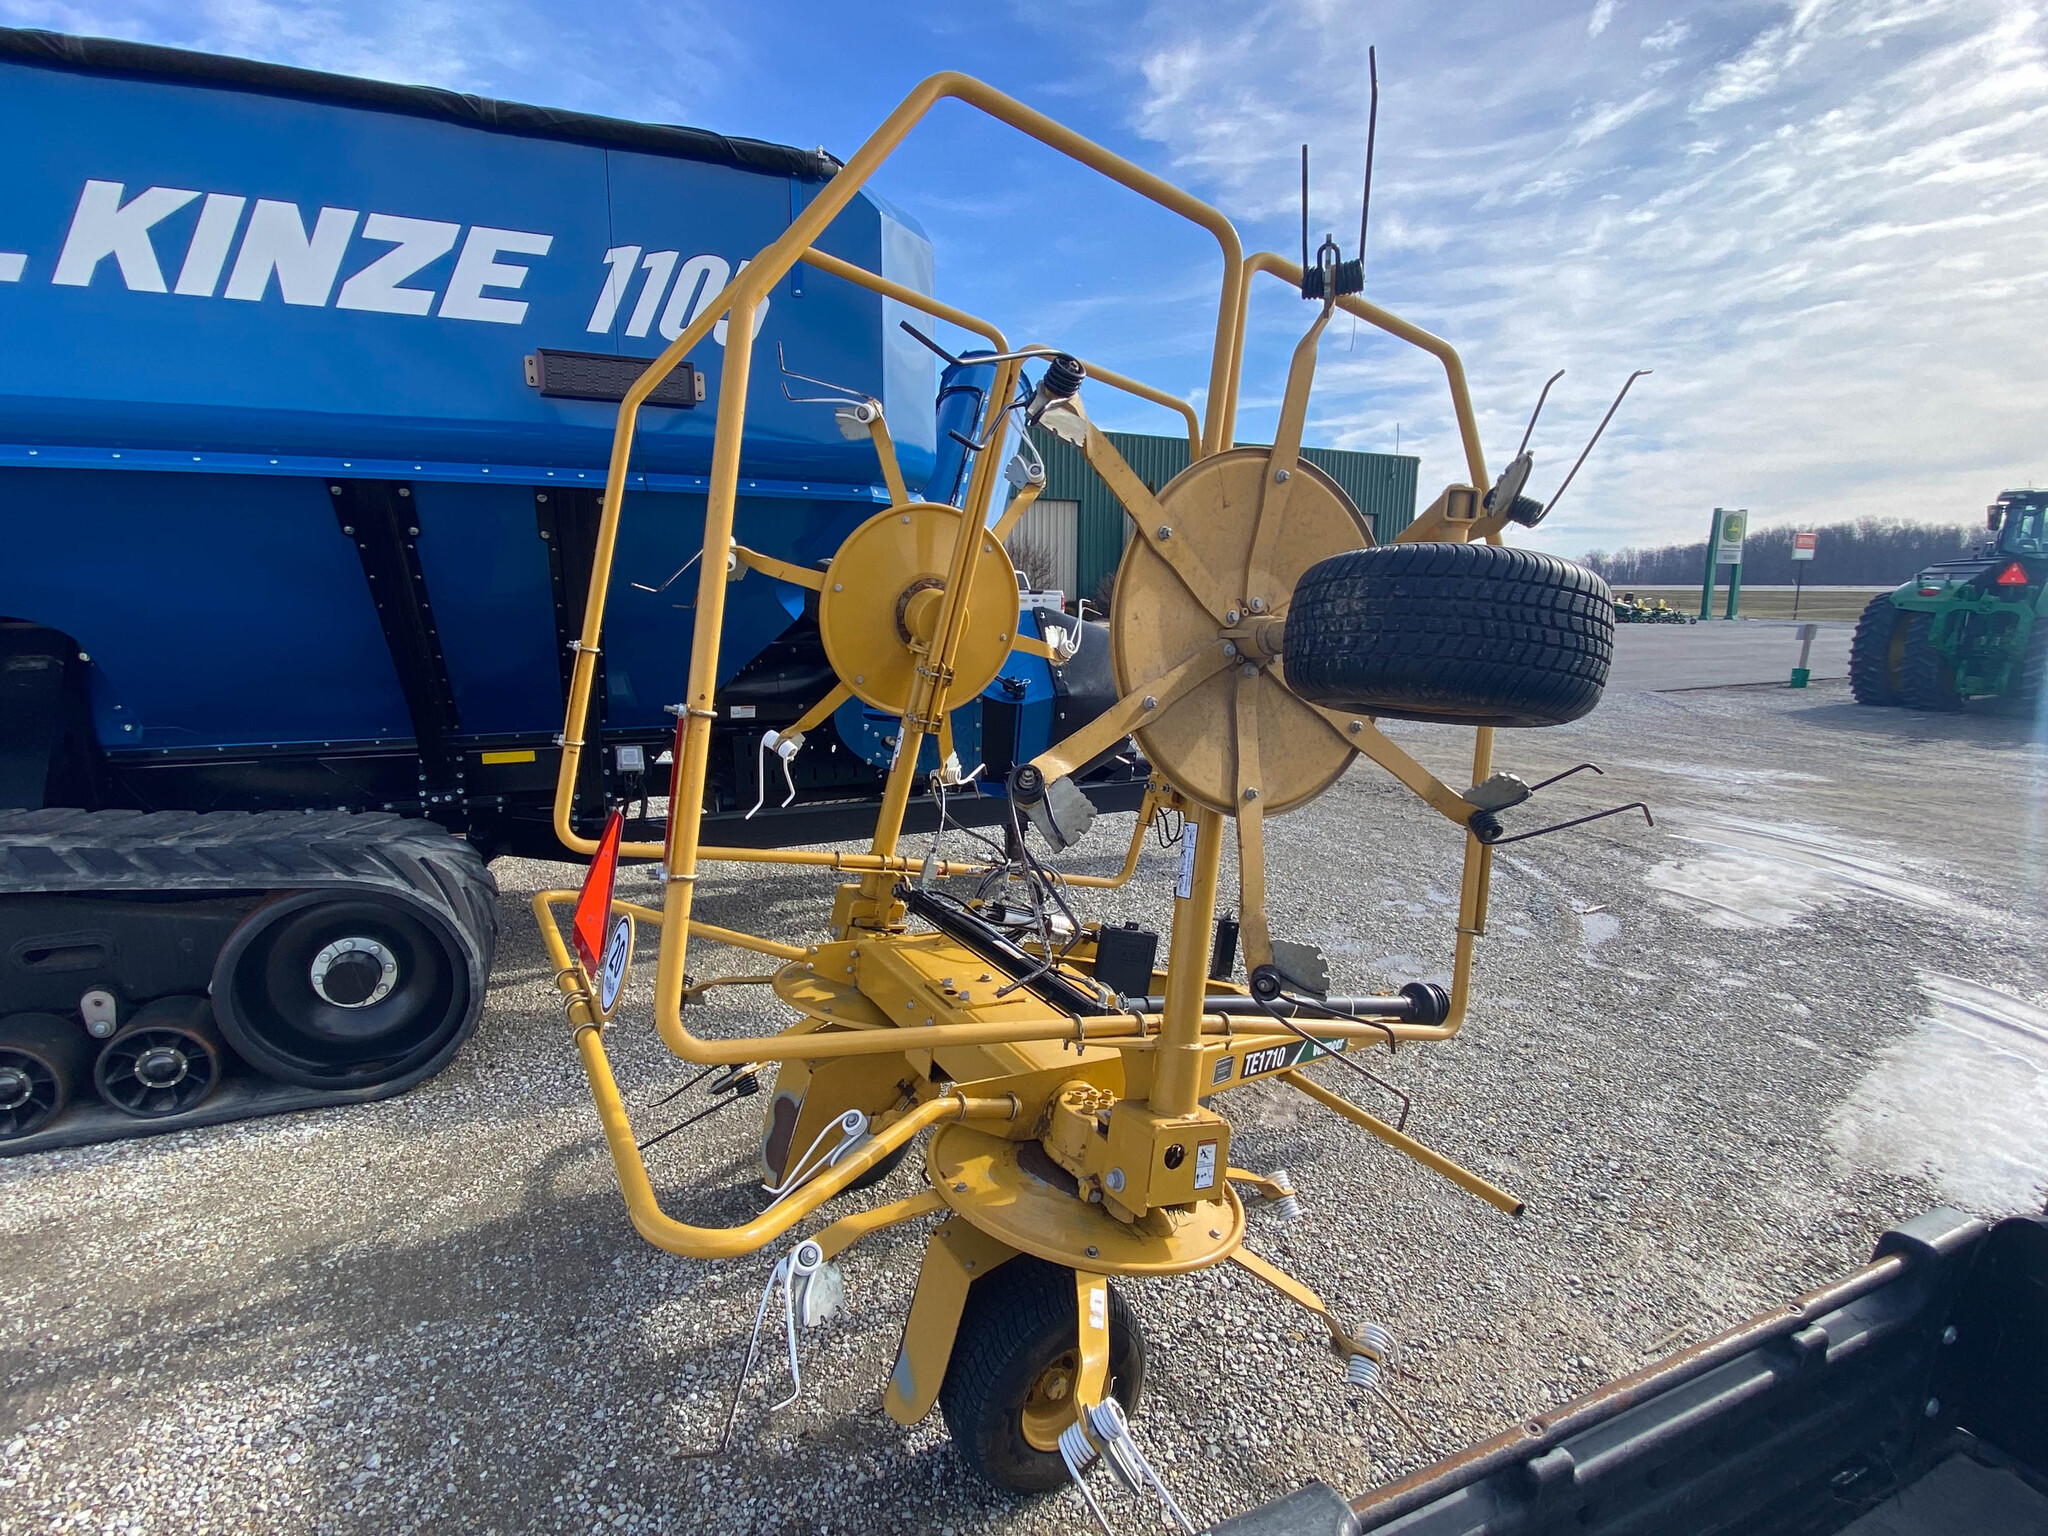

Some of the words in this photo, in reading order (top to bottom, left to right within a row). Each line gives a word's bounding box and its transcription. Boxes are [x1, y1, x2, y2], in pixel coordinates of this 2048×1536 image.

[52, 179, 553, 325] KINZE
[608, 933, 626, 979] 20
[1244, 1046, 1287, 1076] TE1710
